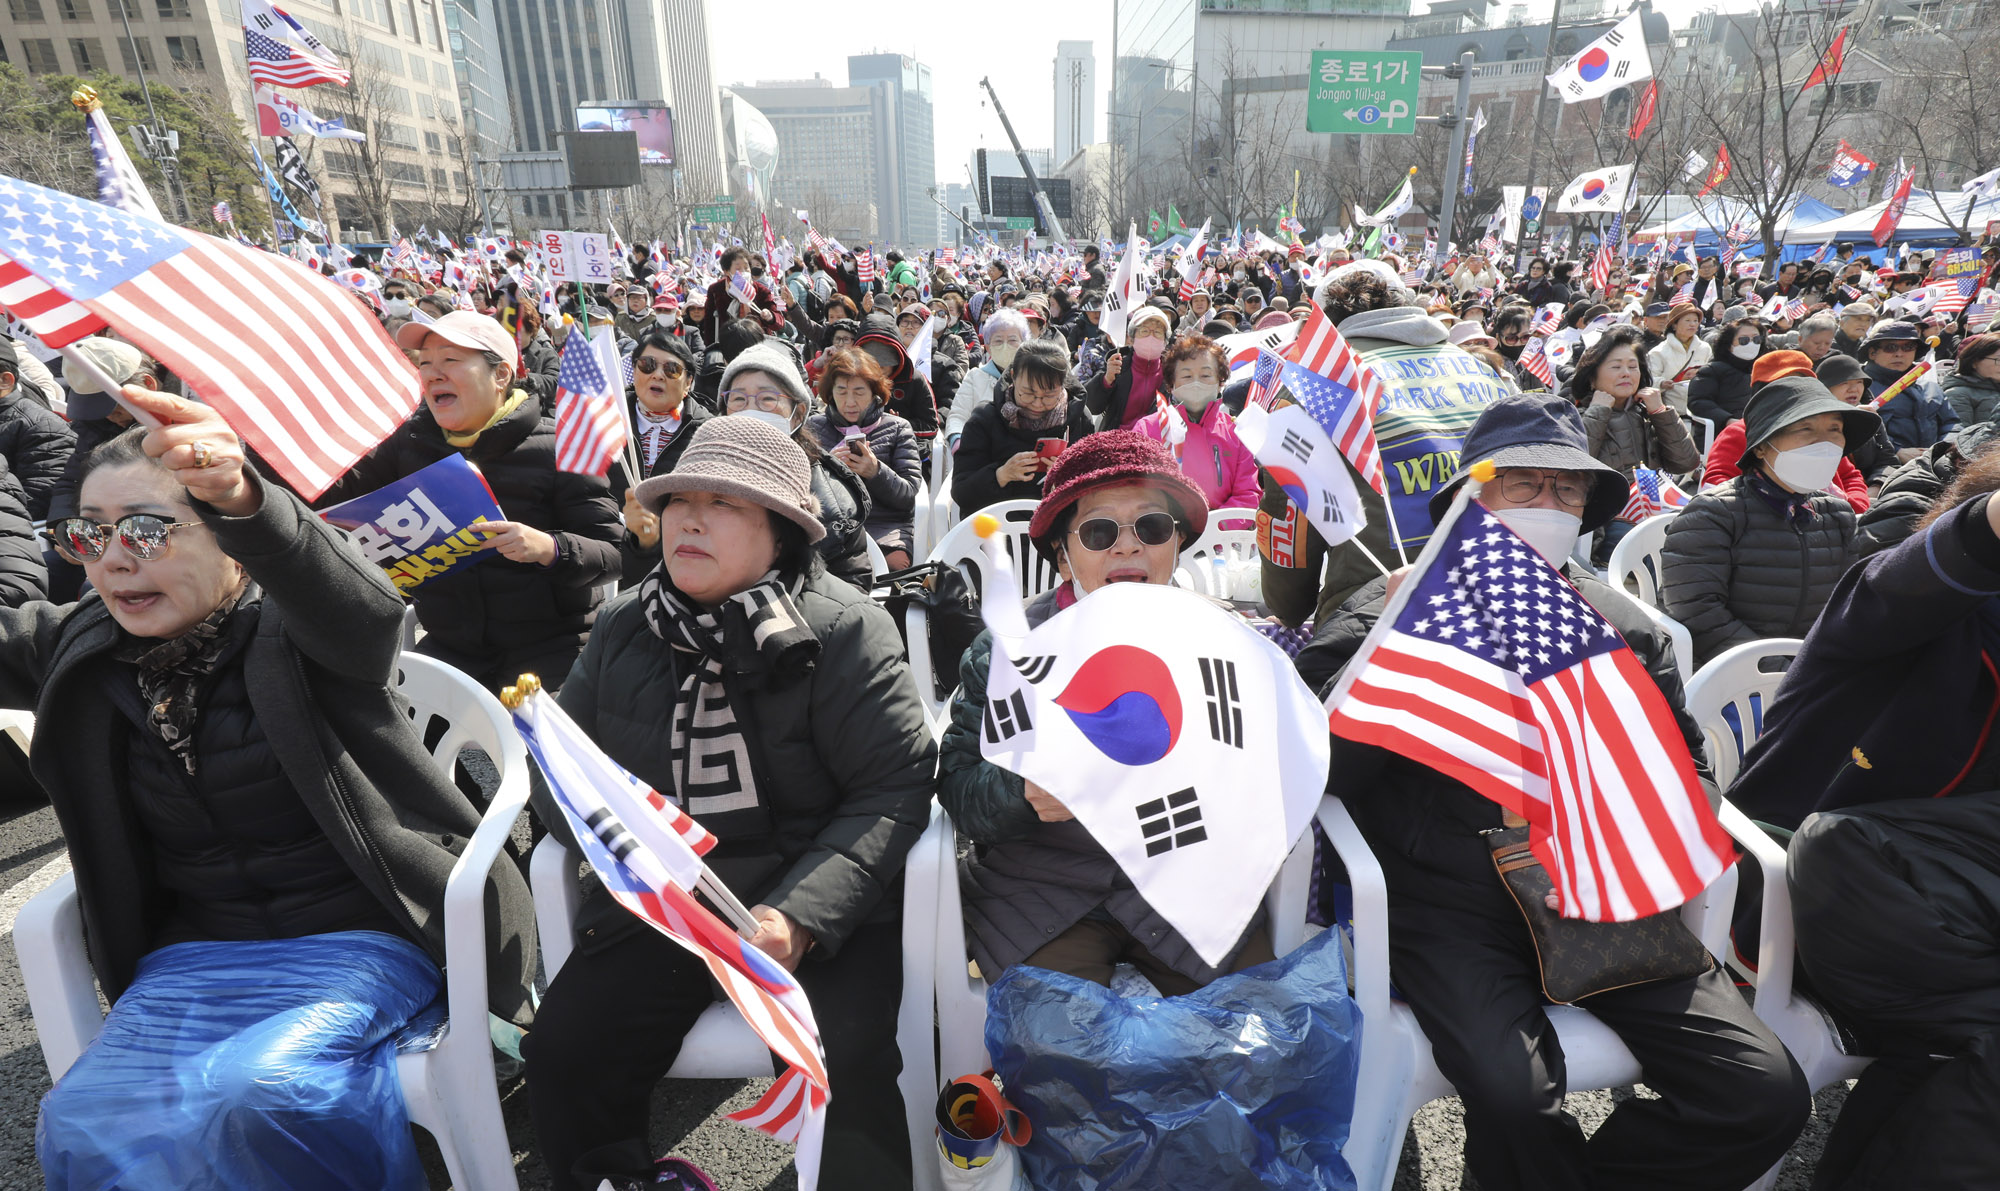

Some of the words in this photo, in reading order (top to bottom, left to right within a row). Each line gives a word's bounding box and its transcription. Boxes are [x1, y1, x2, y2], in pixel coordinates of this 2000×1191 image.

[1319, 58, 1410, 85] 종로1가
[1316, 86, 1351, 103] Jongno
[1355, 87, 1386, 103] 1(il)-ga
[1364, 108, 1374, 122] 6
[545, 234, 566, 277] 용인
[583, 236, 608, 278] 6호
[1369, 355, 1500, 381] ANSFIEL
[1375, 385, 1456, 416] DARK
[1257, 512, 1269, 547] Only
